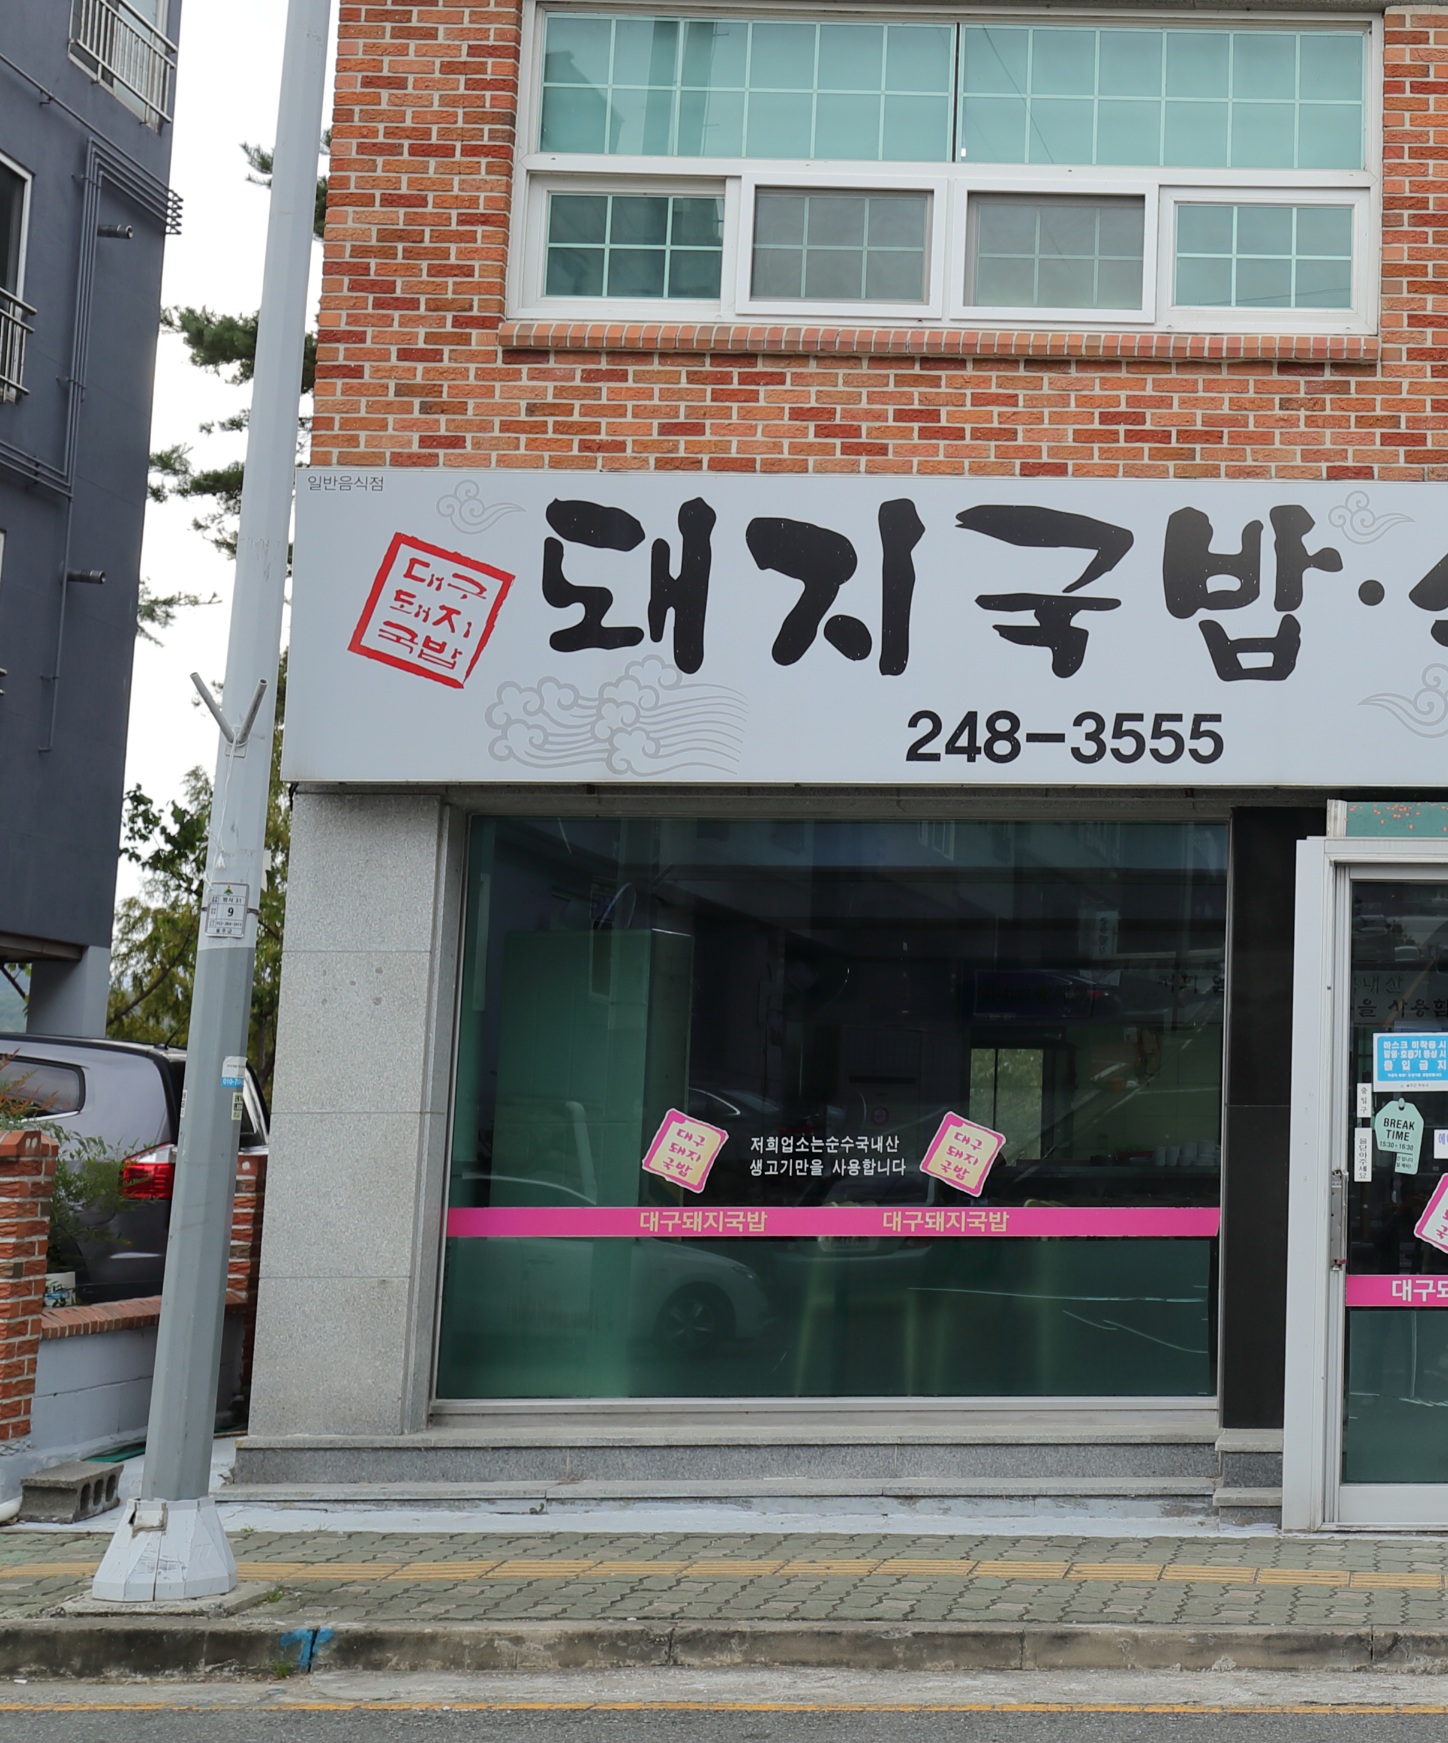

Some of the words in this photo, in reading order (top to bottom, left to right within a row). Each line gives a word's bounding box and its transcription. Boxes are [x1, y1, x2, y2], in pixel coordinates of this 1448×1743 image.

[307, 475, 385, 492] 일반음식점
[401, 557, 488, 602] 대구
[391, 588, 474, 638] 돼지
[380, 619, 465, 670] 국밥
[905, 709, 1225, 764] 248-3555
[1383, 1040, 1408, 1049] 마스크
[1438, 1040, 1447, 1049] 시
[1383, 1118, 1415, 1131] BREAK
[1386, 1129, 1410, 1142] TIME
[675, 1127, 707, 1149] 대구
[750, 1135, 900, 1154] 저희업소는순수국내산
[952, 1131, 983, 1153] 대구
[1399, 1141, 1414, 1151] 16:30
[668, 1141, 702, 1165] 돼지
[946, 1146, 978, 1168] 돼지
[661, 1158, 693, 1179] 국밥
[750, 1158, 823, 1177] 생고기만을
[832, 1158, 906, 1177] 사용합니다
[941, 1161, 971, 1182] 국밥
[640, 1209, 768, 1233] 대구돼지국밥
[882, 1210, 1010, 1233] 대구돼지국밥
